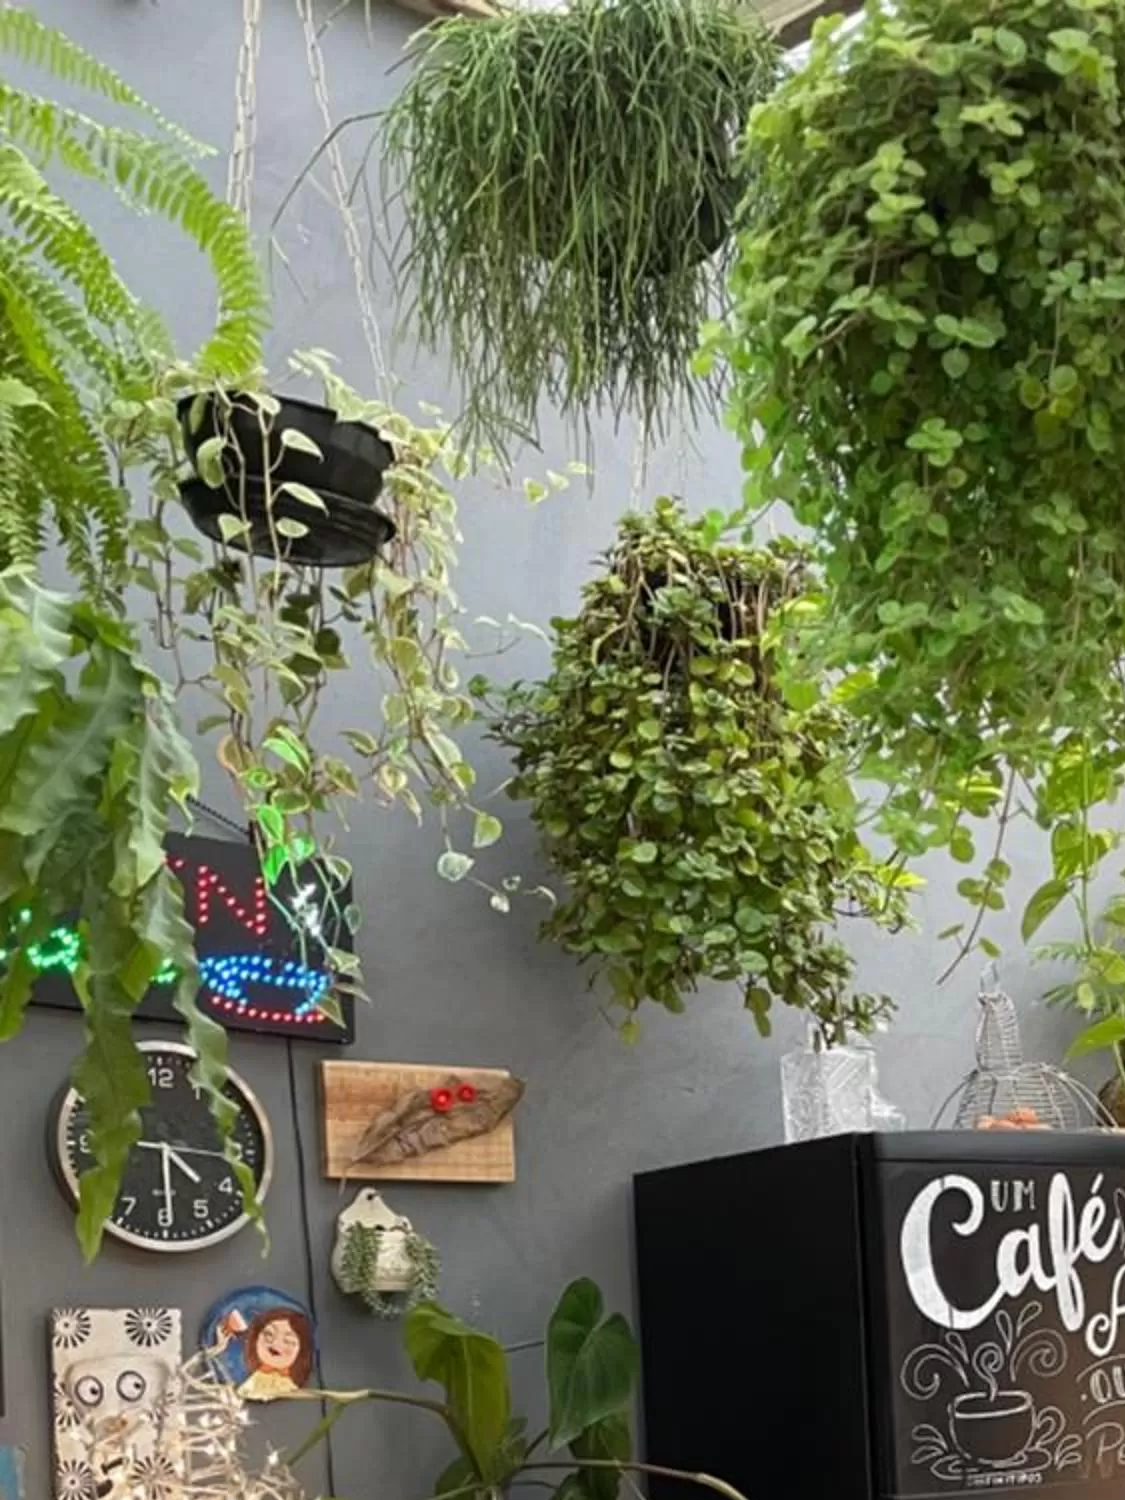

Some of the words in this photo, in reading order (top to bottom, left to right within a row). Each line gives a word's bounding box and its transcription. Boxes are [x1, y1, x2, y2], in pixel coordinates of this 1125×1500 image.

[148, 1068, 174, 1089] 12
[218, 1176, 233, 1194] 4
[990, 1179, 1036, 1212] UM
[121, 1196, 137, 1216] 7
[193, 1199, 209, 1218] 5
[900, 1171, 1120, 1332] Café
